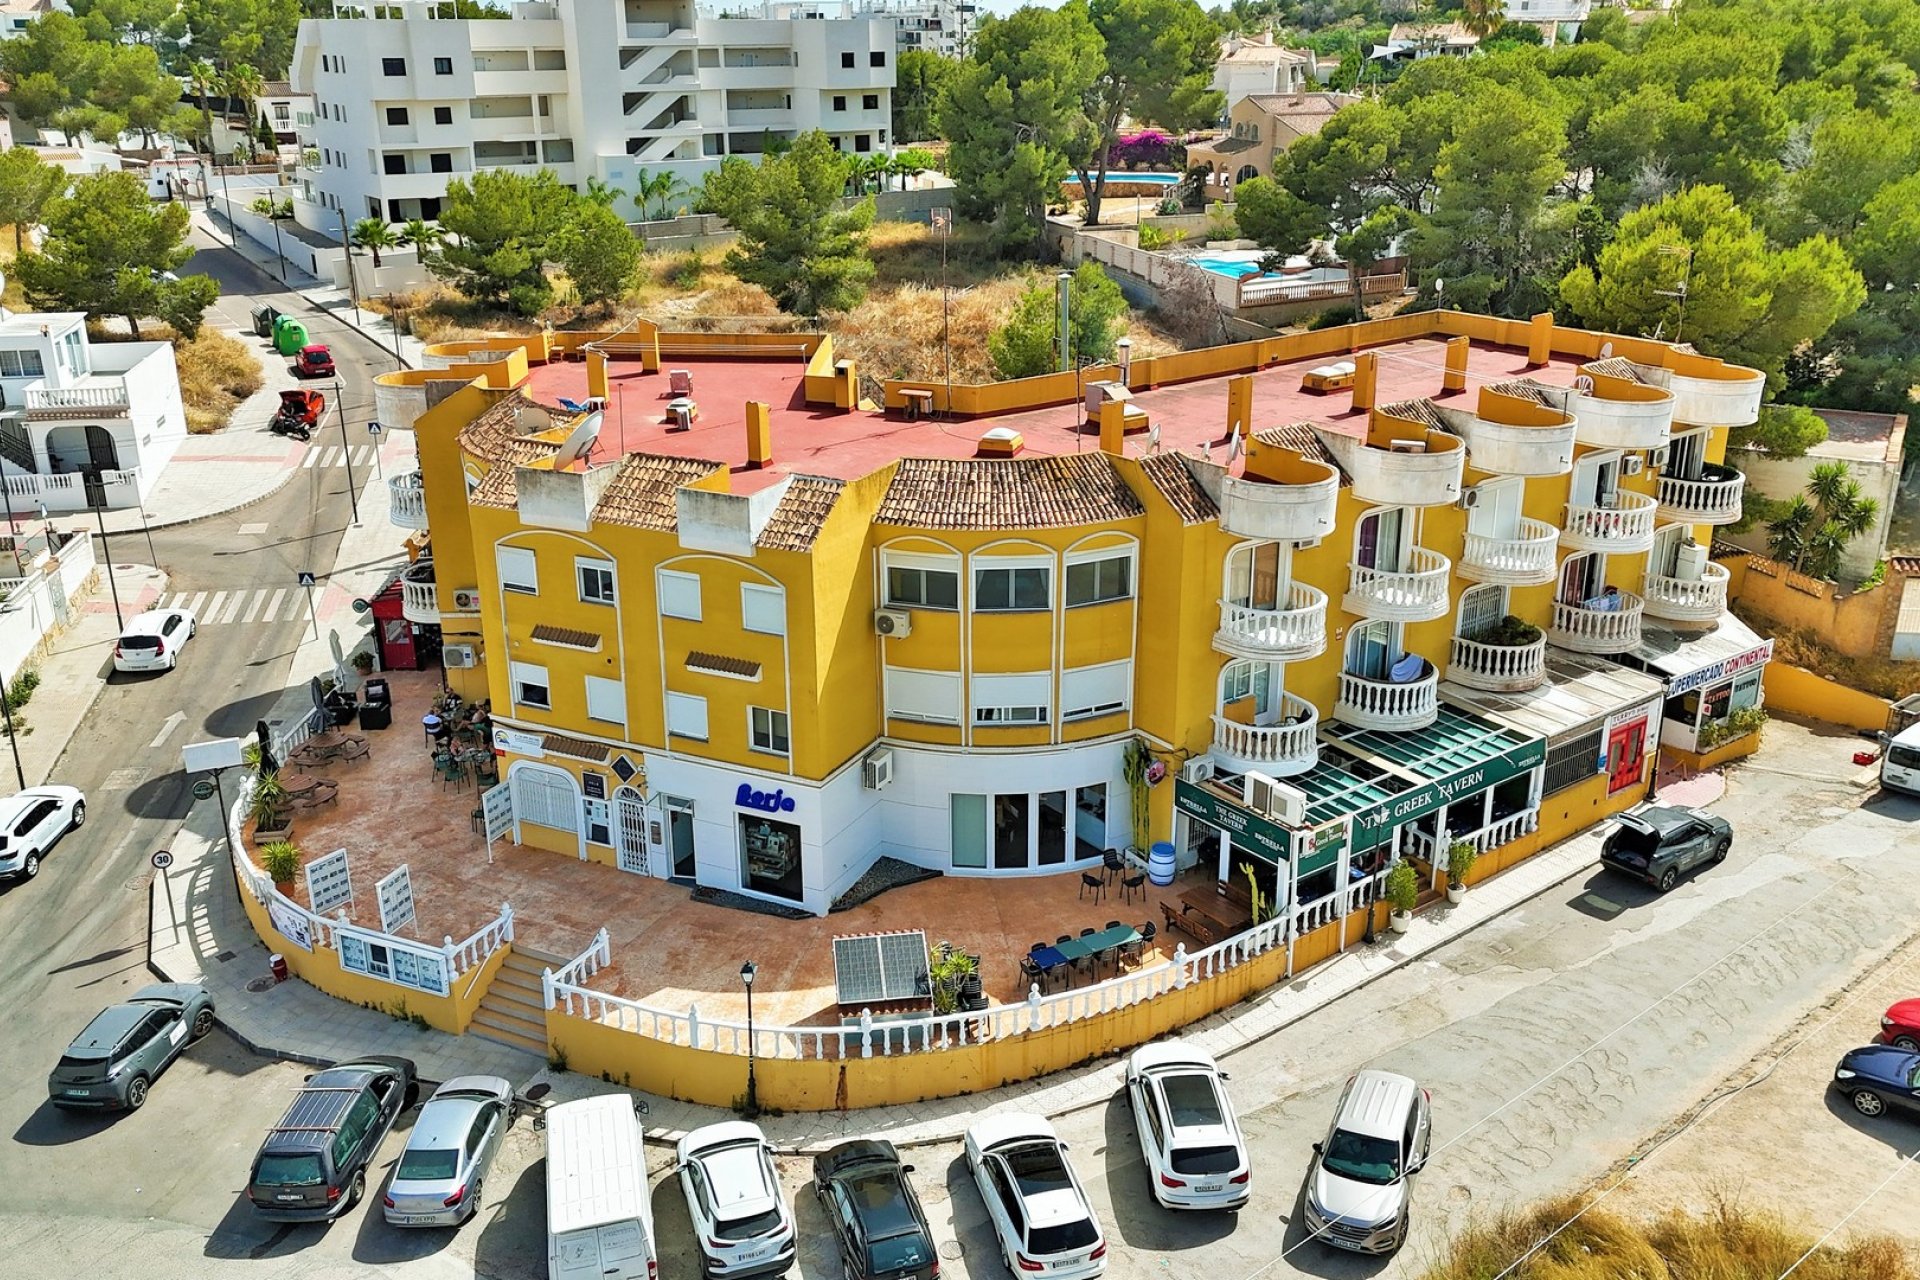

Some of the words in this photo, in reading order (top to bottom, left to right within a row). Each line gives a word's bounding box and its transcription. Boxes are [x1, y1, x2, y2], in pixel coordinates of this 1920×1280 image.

[1724, 645, 1771, 674] CONTINENTAL
[1394, 791, 1433, 817] GREEK
[1437, 769, 1485, 799] TAVERN
[156, 855, 170, 865] 30
